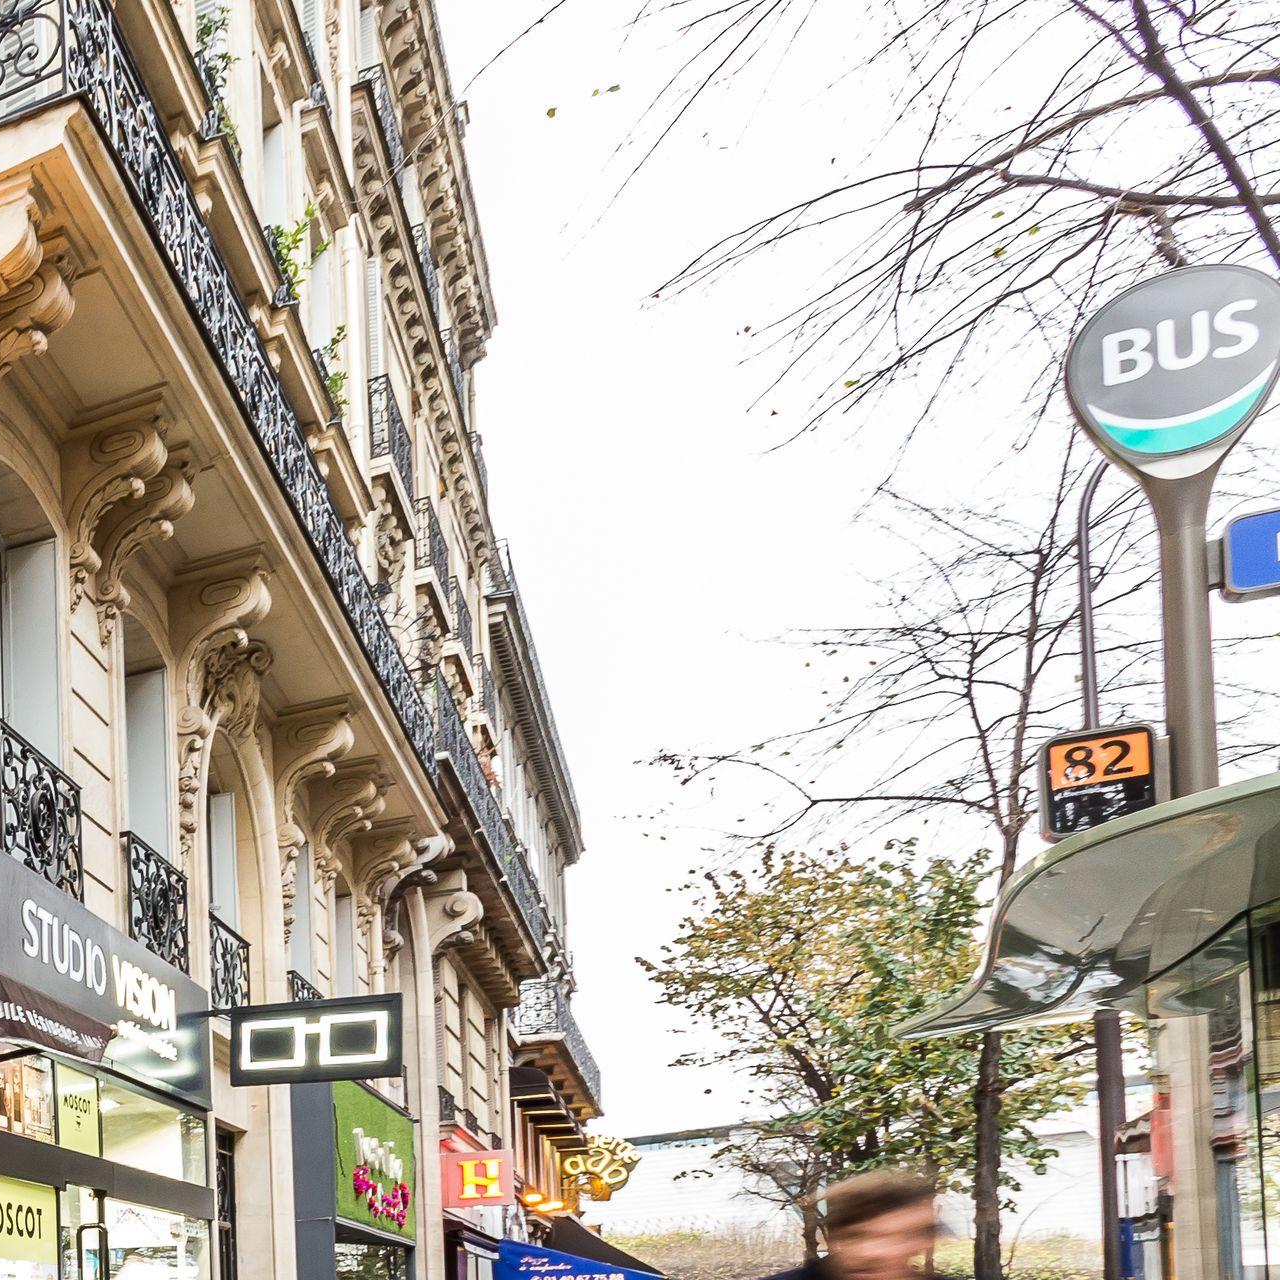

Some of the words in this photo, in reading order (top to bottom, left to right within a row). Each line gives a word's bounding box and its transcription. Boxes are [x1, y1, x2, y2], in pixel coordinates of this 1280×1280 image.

[1102, 298, 1260, 387] BUS
[1063, 739, 1135, 782] 82
[21, 898, 108, 997] STUDIO
[111, 953, 177, 1033] VISION
[63, 1093, 91, 1116] MOSCOT
[457, 1157, 504, 1199] H
